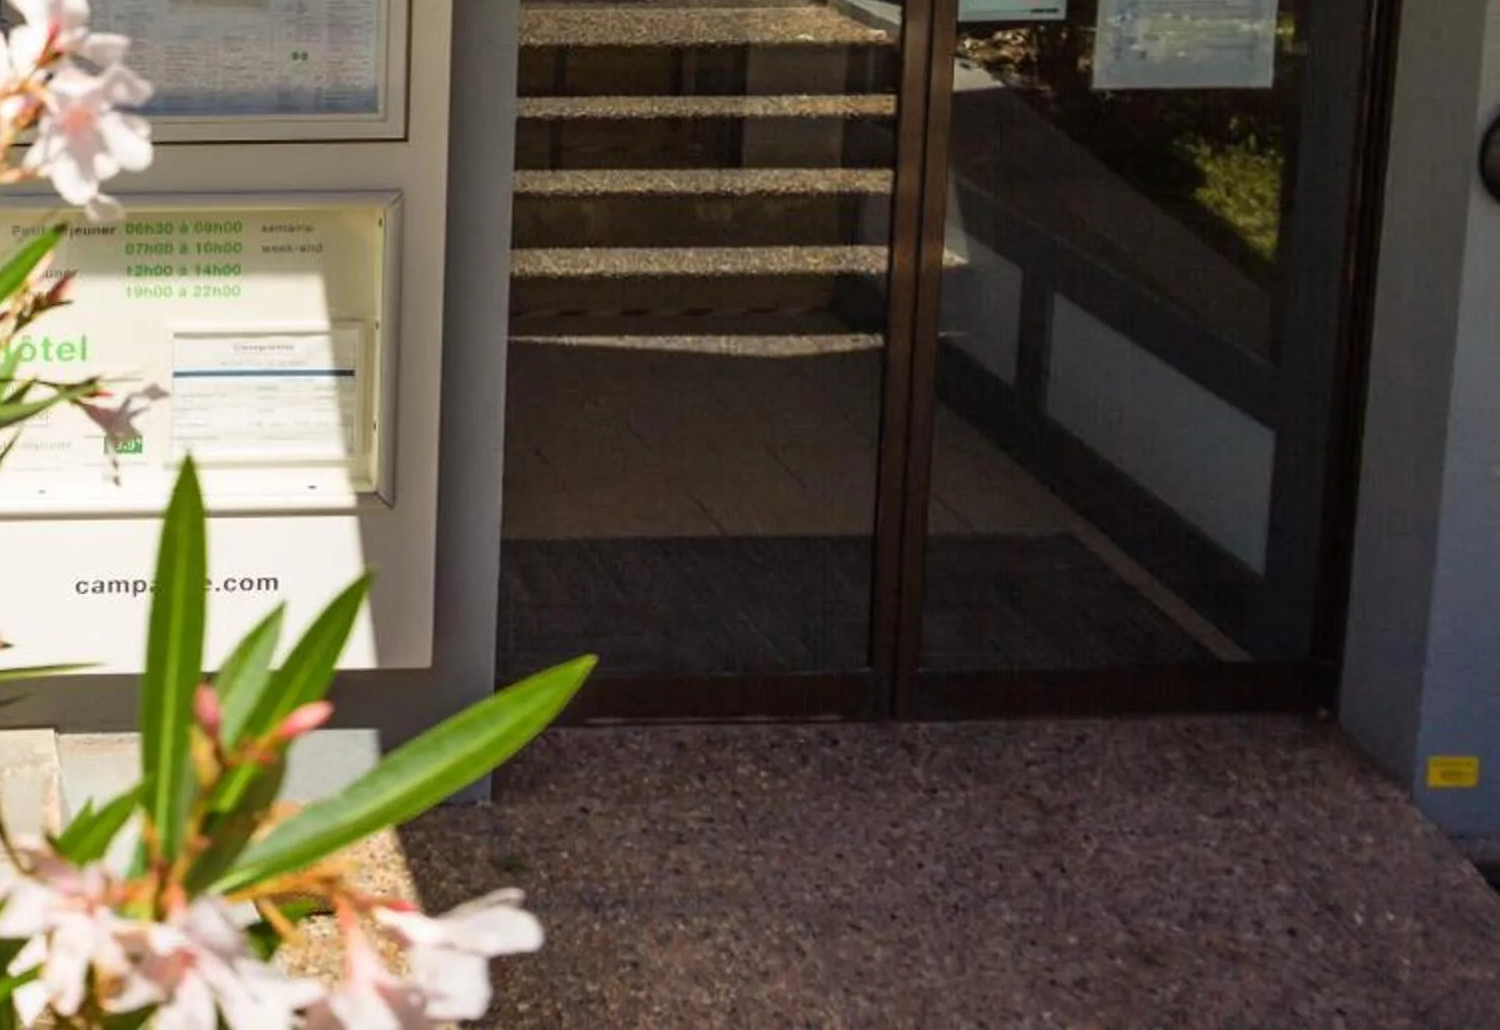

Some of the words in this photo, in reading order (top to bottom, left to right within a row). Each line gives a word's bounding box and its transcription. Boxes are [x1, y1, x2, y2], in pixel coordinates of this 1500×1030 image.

[125, 242, 173, 256] 07h00
[196, 241, 243, 255] 10h00
[195, 264, 242, 277] 14h00
[193, 284, 242, 298] 22h00
[75, 576, 279, 597] camp.com
